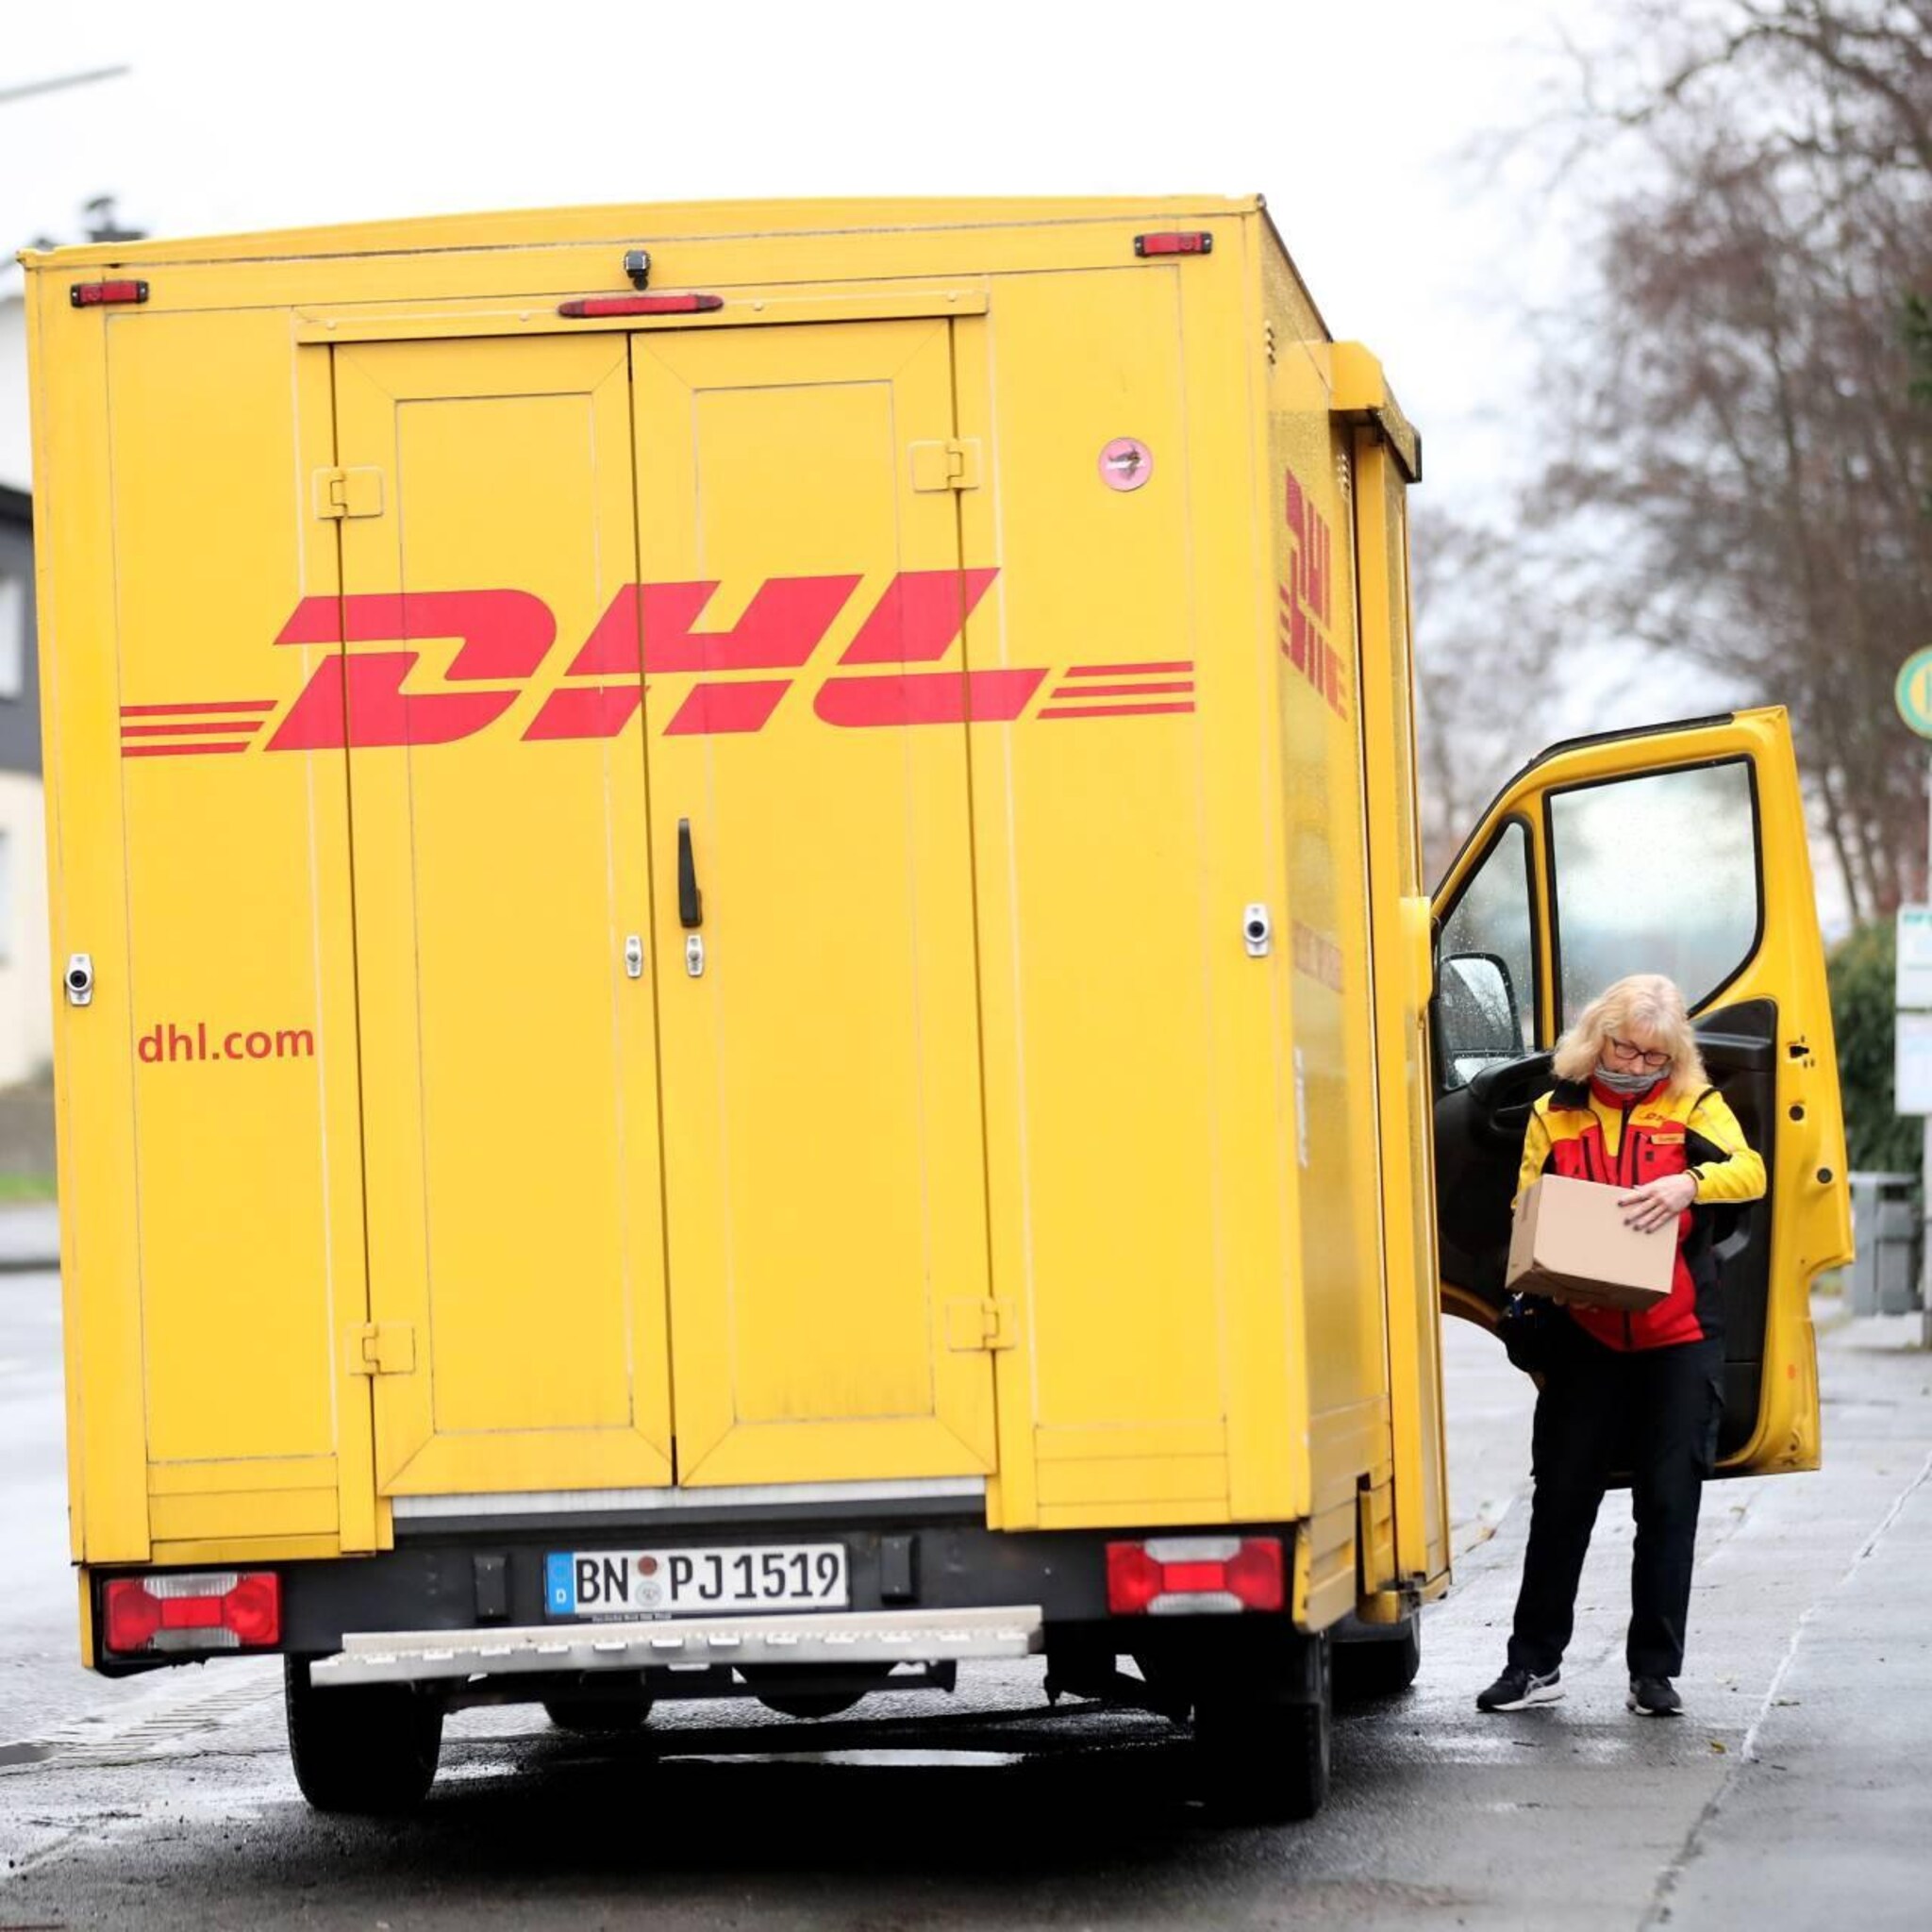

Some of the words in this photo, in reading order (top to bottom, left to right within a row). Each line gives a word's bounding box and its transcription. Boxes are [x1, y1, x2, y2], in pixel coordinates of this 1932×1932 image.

[263, 567, 1049, 752] DHL
[138, 1022, 314, 1063] dhl.com
[575, 1557, 629, 1604] BN
